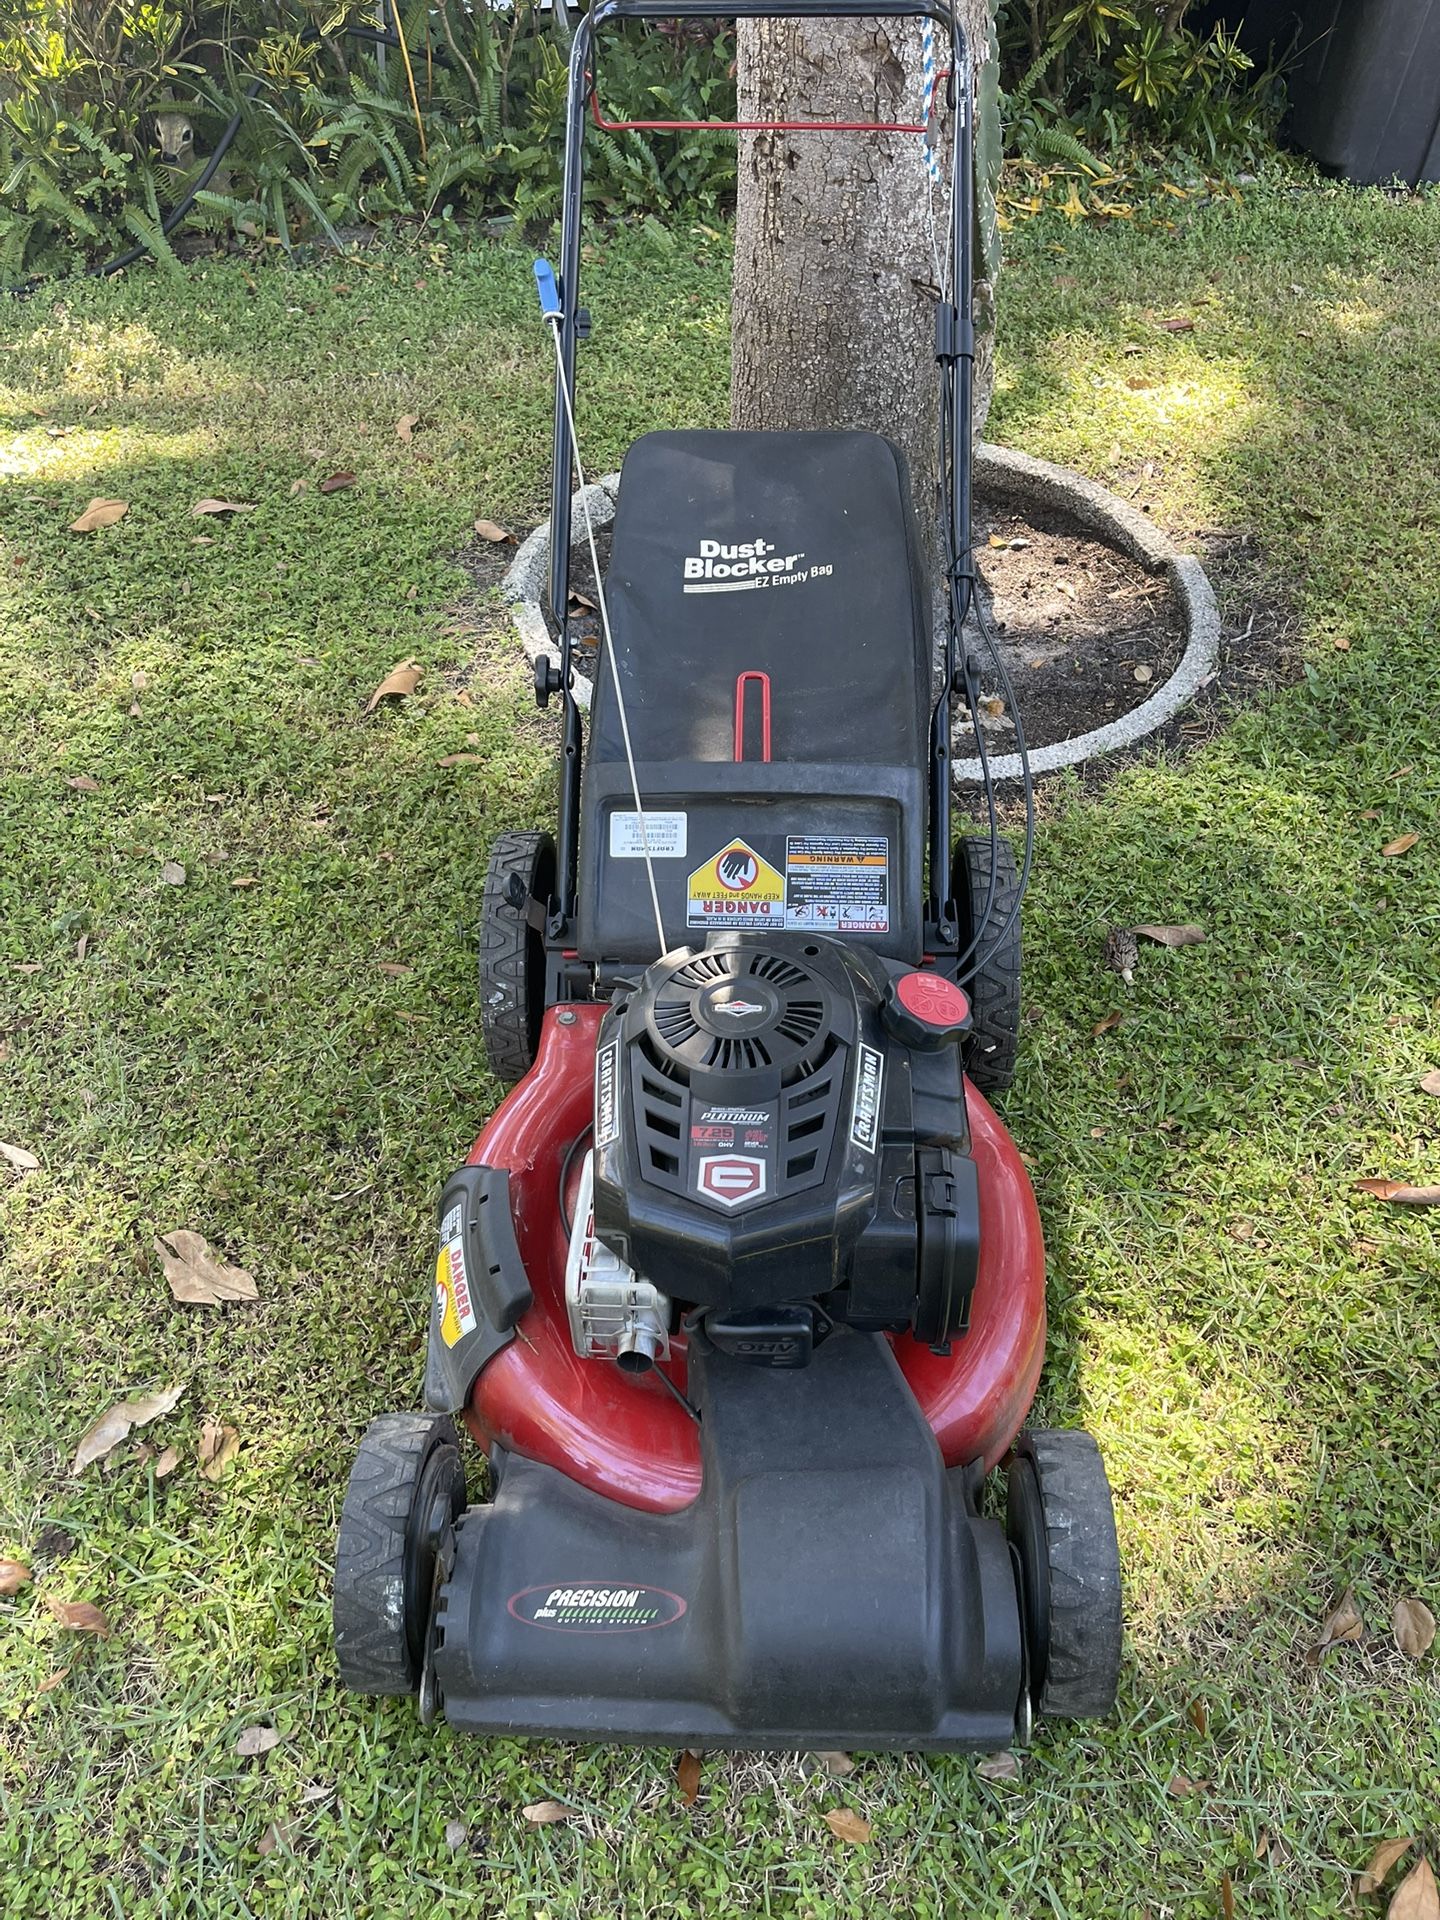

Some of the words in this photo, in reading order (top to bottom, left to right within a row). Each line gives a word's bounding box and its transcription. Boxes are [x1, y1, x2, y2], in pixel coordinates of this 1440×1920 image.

[700, 539, 774, 559] Dust-
[756, 577, 769, 588] EZ
[773, 572, 808, 586] Empty
[810, 564, 833, 578] Bag
[703, 900, 771, 914] DANGER
[841, 921, 876, 929] DANGER
[600, 1050, 615, 1136] CRAFTSMAN
[854, 1052, 878, 1142] CRAFTSMAN
[701, 1112, 770, 1122] PLATINUM
[699, 1127, 733, 1138] 7.25
[451, 1249, 471, 1318] DANGER
[533, 1607, 557, 1619] plus
